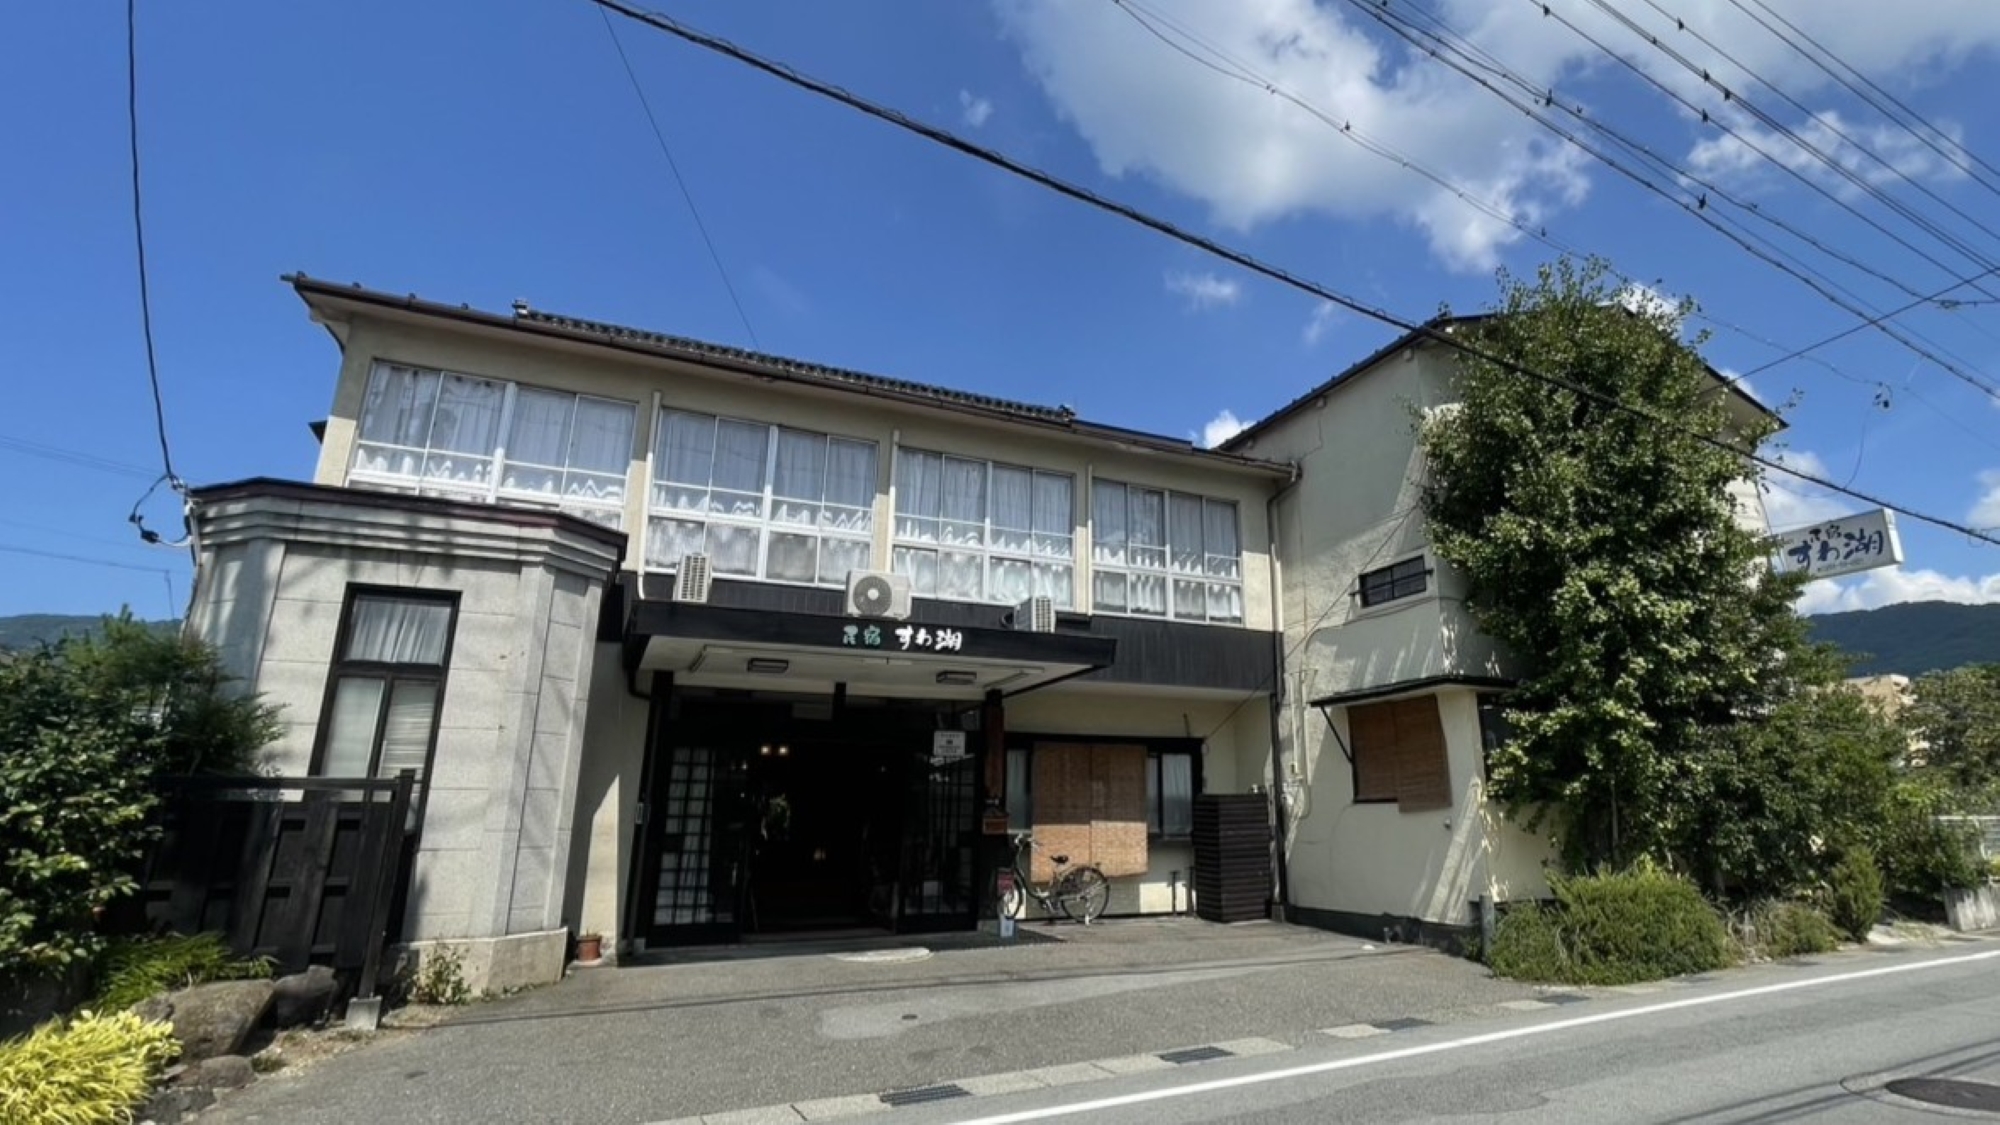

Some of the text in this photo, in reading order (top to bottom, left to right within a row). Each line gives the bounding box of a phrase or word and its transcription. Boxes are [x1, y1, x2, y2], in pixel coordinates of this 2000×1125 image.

[1787, 528, 1884, 570] すわ湖
[895, 624, 962, 651] すわ湖
